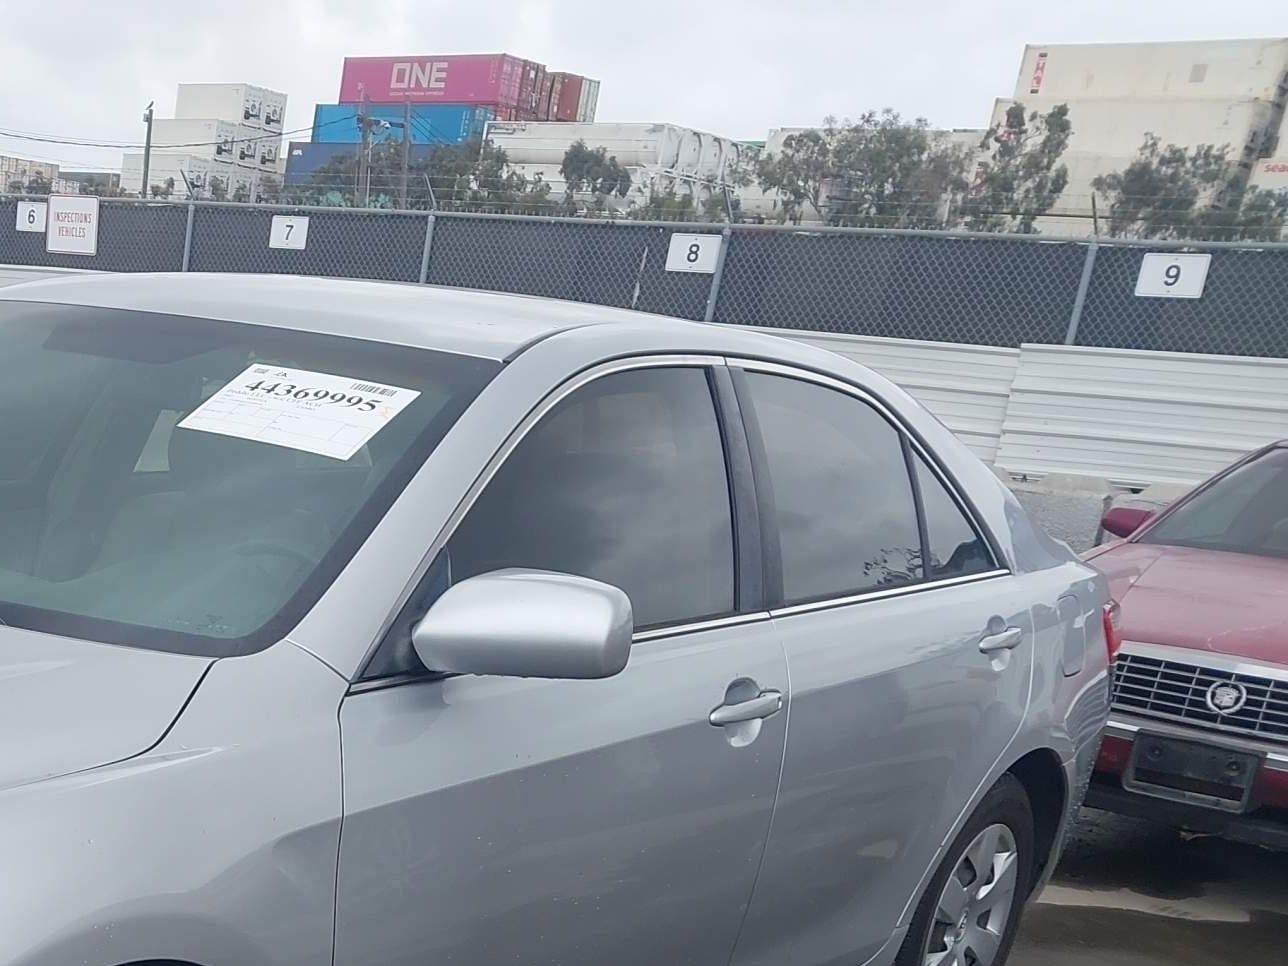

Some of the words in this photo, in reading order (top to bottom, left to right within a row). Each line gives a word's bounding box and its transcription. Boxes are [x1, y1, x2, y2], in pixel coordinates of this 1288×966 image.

[390, 62, 449, 89] ONE
[27, 209, 36, 224] 6
[54, 211, 92, 224] INSPECTIONS
[57, 226, 86, 237] VEHICLES
[285, 224, 294, 241] 7
[686, 243, 700, 263] 8
[1163, 264, 1181, 287] 9
[245, 379, 383, 412] 44369995
